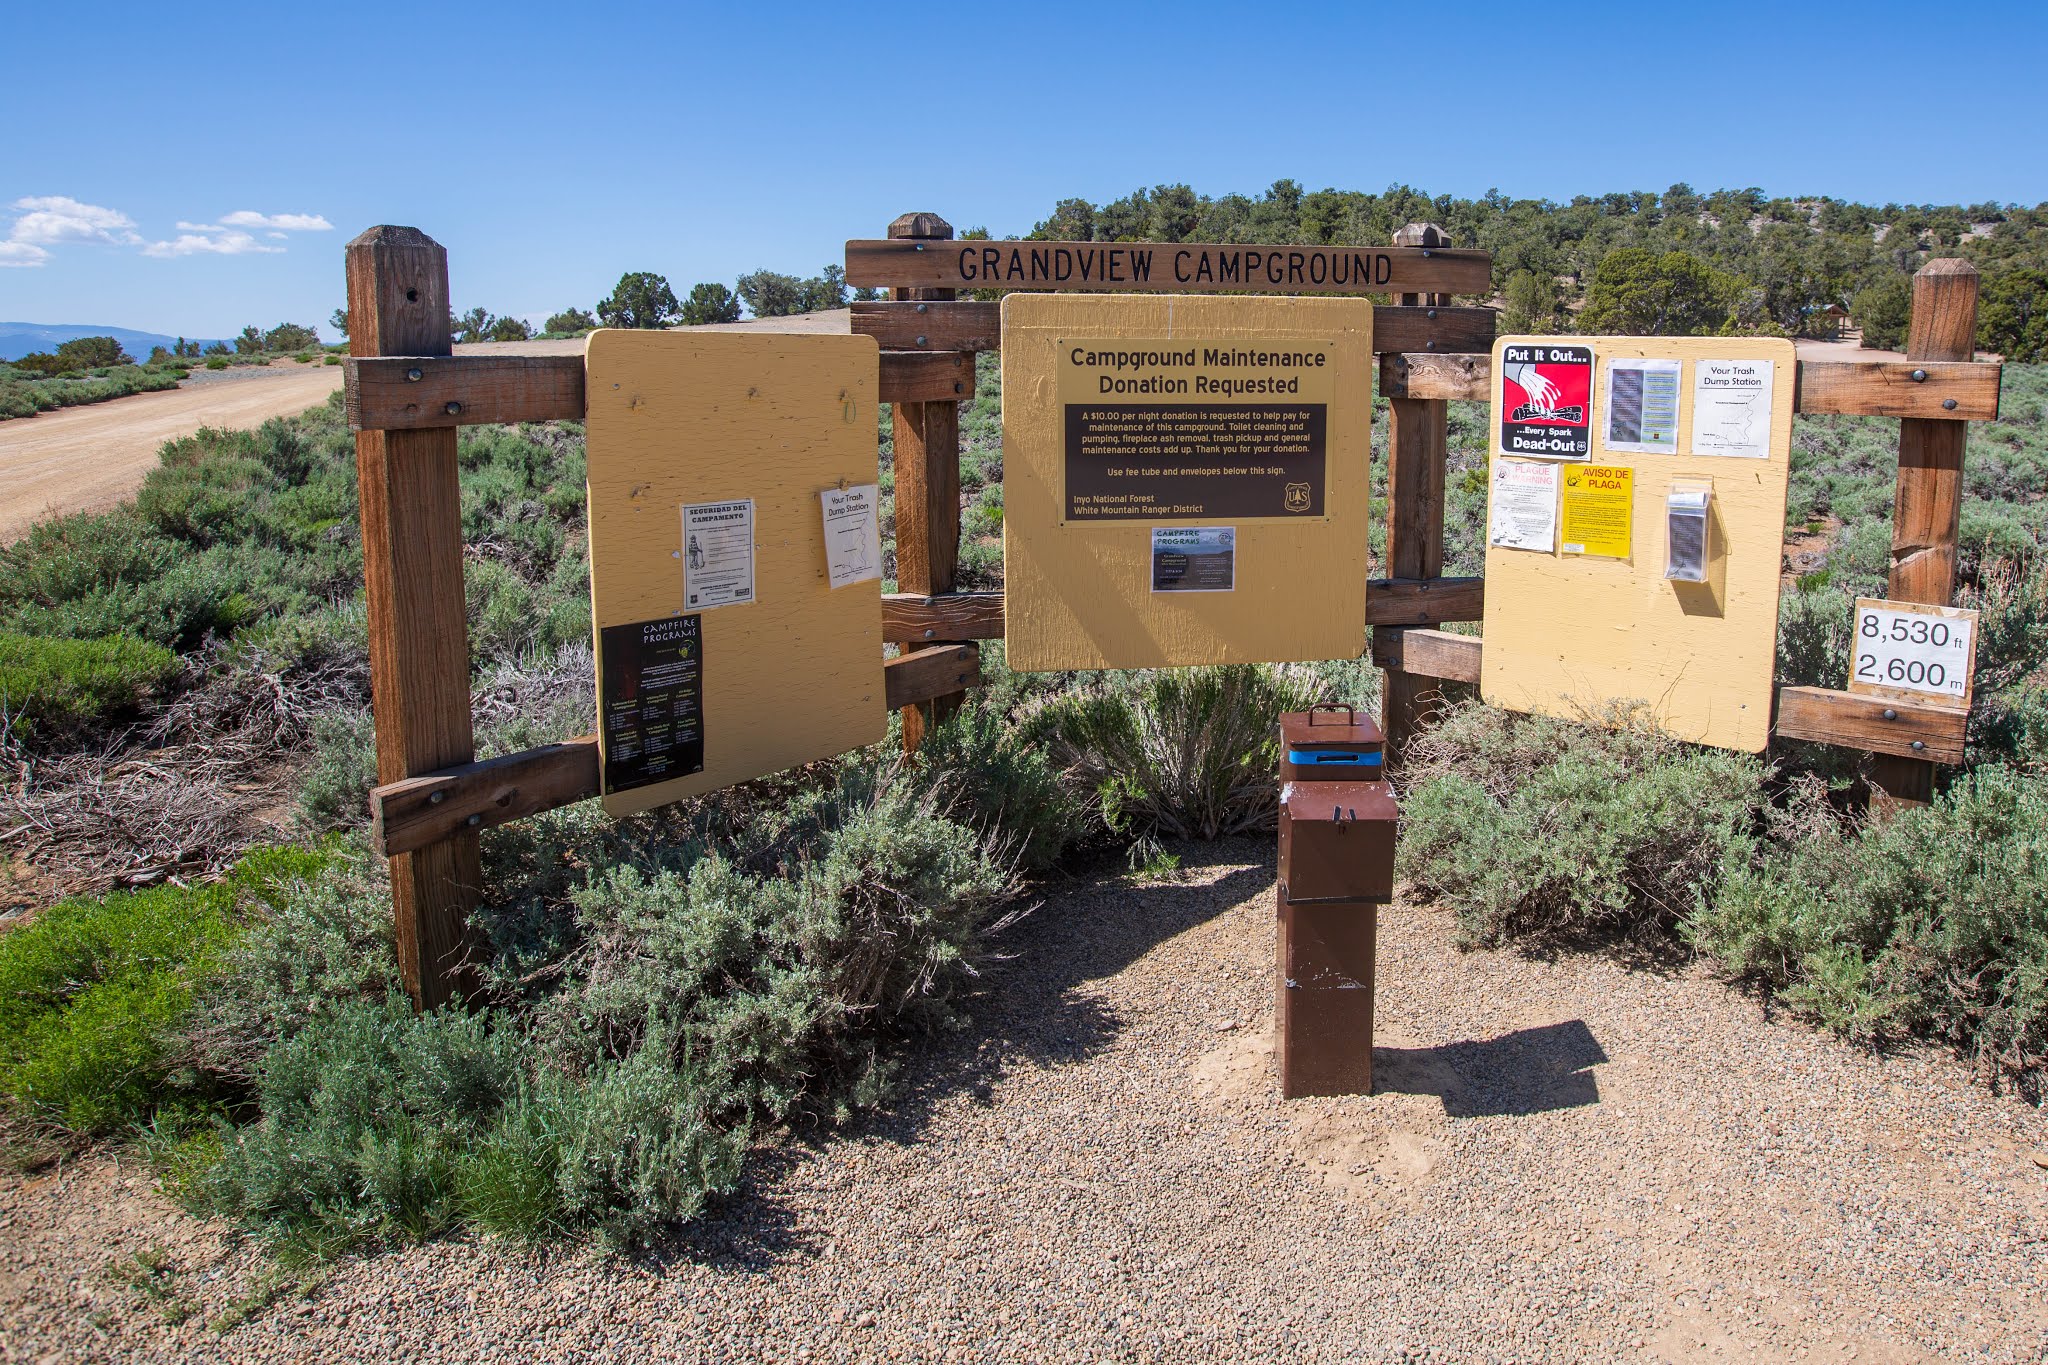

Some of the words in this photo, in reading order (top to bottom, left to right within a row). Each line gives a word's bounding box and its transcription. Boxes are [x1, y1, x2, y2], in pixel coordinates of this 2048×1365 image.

[958, 247, 1154, 282] GRANDVIEW
[1174, 250, 1392, 285] CAMPGROUND
[1071, 348, 1196, 371] Campground
[1203, 348, 1326, 367] Maintenance
[1507, 349, 1529, 361] Put
[1534, 350, 1545, 361] It
[1550, 349, 1587, 362] Out...
[1711, 366, 1731, 375] Your
[1733, 366, 1755, 375] Trash
[1100, 375, 1188, 394] Donation
[1196, 376, 1299, 398] Requested
[1704, 377, 1730, 386] Dump
[1732, 377, 1762, 386] Station
[1082, 412, 1089, 420] A
[1091, 412, 1120, 421] $10.00
[1122, 413, 1135, 422] per
[1138, 412, 1160, 422] night
[1162, 412, 1198, 420] donation
[1200, 412, 1207, 420] is
[1209, 412, 1250, 421] requested
[1252, 412, 1261, 420] to
[1263, 412, 1281, 421] help
[1283, 413, 1297, 422] pay
[1299, 411, 1310, 420] for
[1089, 423, 1143, 432] maintenance
[1146, 423, 1155, 431] of
[1157, 423, 1172, 431] this
[1174, 423, 1227, 433] campground.
[1229, 423, 1251, 431] Toilet
[1253, 423, 1287, 432] cleaning
[1289, 423, 1304, 431] and
[1516, 426, 1546, 436] ...Every
[1548, 427, 1572, 437] Spark
[1122, 434, 1158, 444] fireplace
[1160, 434, 1175, 442] ash
[1213, 434, 1234, 442] trash
[1236, 434, 1262, 443] pickup
[1264, 434, 1279, 442] and
[1281, 433, 1311, 443] general
[1513, 436, 1576, 452] Dead-Out
[1082, 446, 1137, 454] maintenance
[1139, 446, 1161, 454] costs
[1163, 445, 1179, 454] add
[1181, 446, 1193, 455] up.
[1196, 445, 1220, 453] Thank
[1222, 446, 1237, 455] you
[1240, 445, 1251, 453] for
[1253, 446, 1271, 455] your
[1273, 444, 1310, 453] donation.
[1107, 468, 1123, 476] Use
[1125, 467, 1139, 476] fee
[1141, 467, 1160, 476] tube
[1163, 467, 1178, 476] and
[1180, 467, 1221, 477] envelopes
[1223, 467, 1247, 475] below
[1250, 466, 1265, 475] this
[1267, 466, 1286, 476] sign.
[1515, 465, 1550, 476] PLAGUE
[1583, 468, 1612, 478] AVISO
[1616, 470, 1629, 479] DE
[1513, 474, 1553, 485] WARNING
[1588, 479, 1622, 490] PLAGA
[831, 496, 845, 505] Your
[845, 492, 864, 502] Trash
[1073, 495, 1091, 506] Inyo
[1093, 495, 1127, 504] National
[1129, 494, 1155, 503] Forest
[689, 506, 732, 515] SEGURIDAD
[828, 507, 846, 517] Dump
[846, 503, 869, 513] Station
[1073, 506, 1099, 515] White
[1101, 505, 1140, 514] Mountain
[1142, 505, 1171, 516] Ranger
[1173, 504, 1203, 513] District
[692, 514, 744, 523] CAMPAMENTO
[643, 618, 696, 634] CAMPFIRE
[1861, 614, 1949, 647] 8,530
[1954, 637, 1963, 649] ft
[643, 627, 696, 644] PROGRAMS
[1858, 654, 1946, 687] 2,600
[1950, 680, 1963, 690] m
